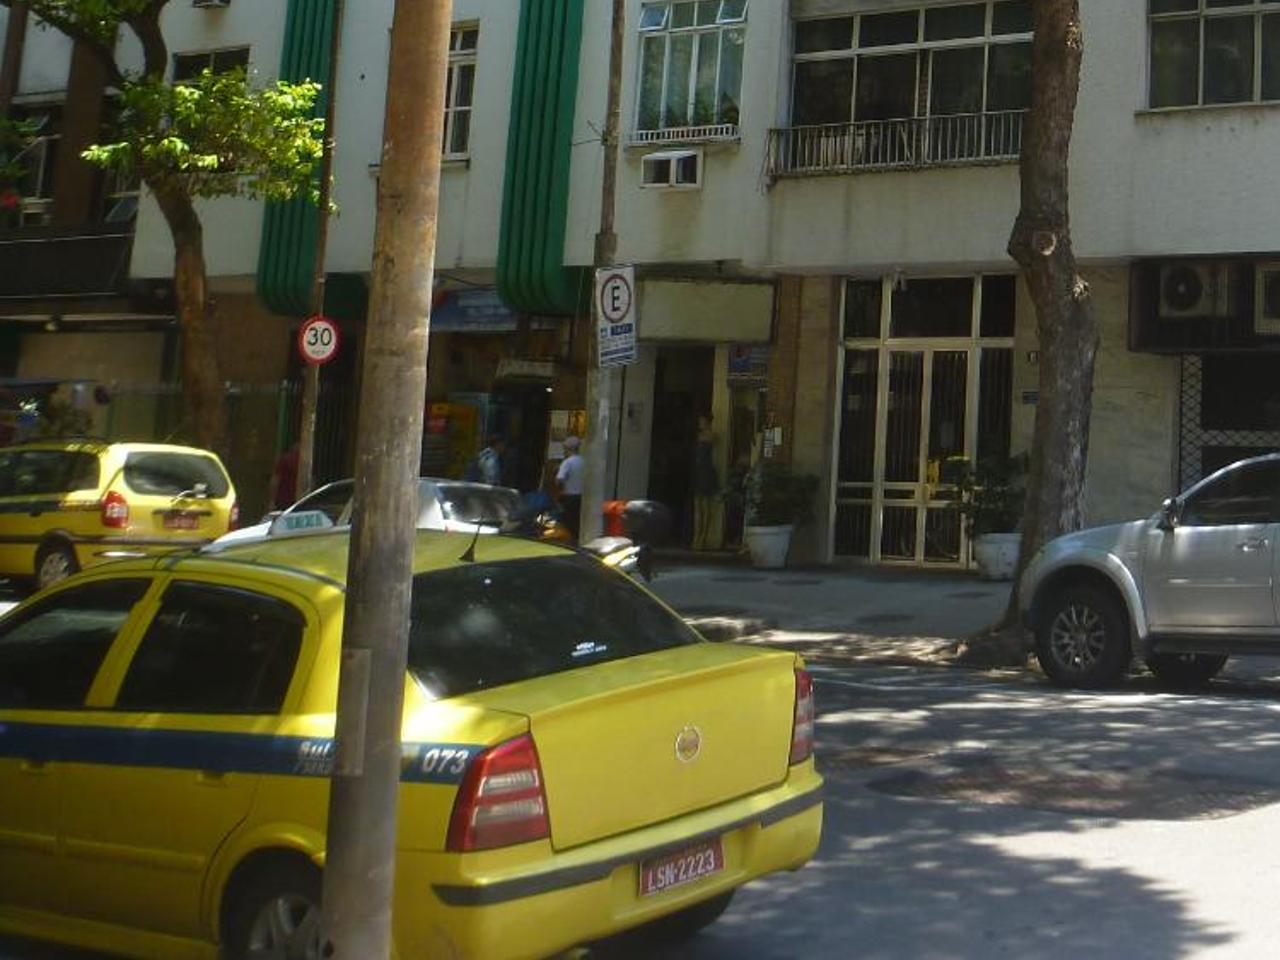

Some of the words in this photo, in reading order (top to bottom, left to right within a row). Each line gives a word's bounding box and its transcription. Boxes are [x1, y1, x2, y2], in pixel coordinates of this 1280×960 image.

[611, 286, 621, 312] E
[307, 327, 332, 346] 30
[422, 748, 469, 773] 073
